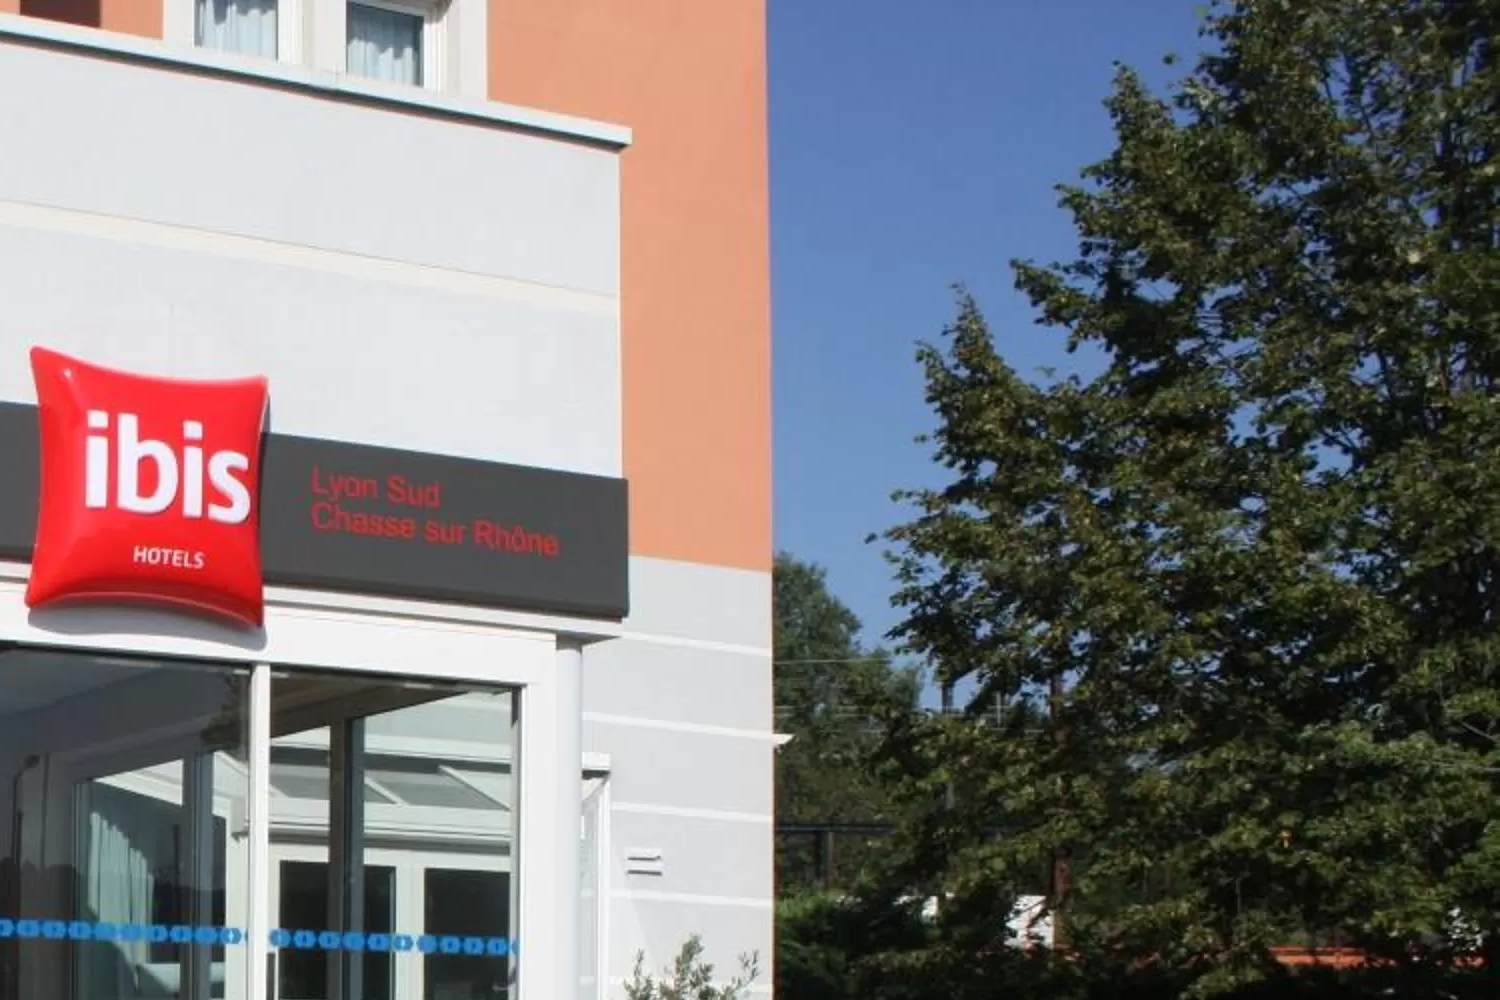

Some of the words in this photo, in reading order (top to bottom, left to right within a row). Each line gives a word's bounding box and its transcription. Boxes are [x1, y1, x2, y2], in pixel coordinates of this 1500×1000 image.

[85, 409, 251, 525] ibis
[311, 464, 379, 501] Lyon
[386, 473, 442, 509] Sud
[310, 501, 416, 540] Chasse
[423, 519, 467, 545] sur
[473, 519, 560, 558] Rhône
[133, 545, 205, 569] HOTELS
